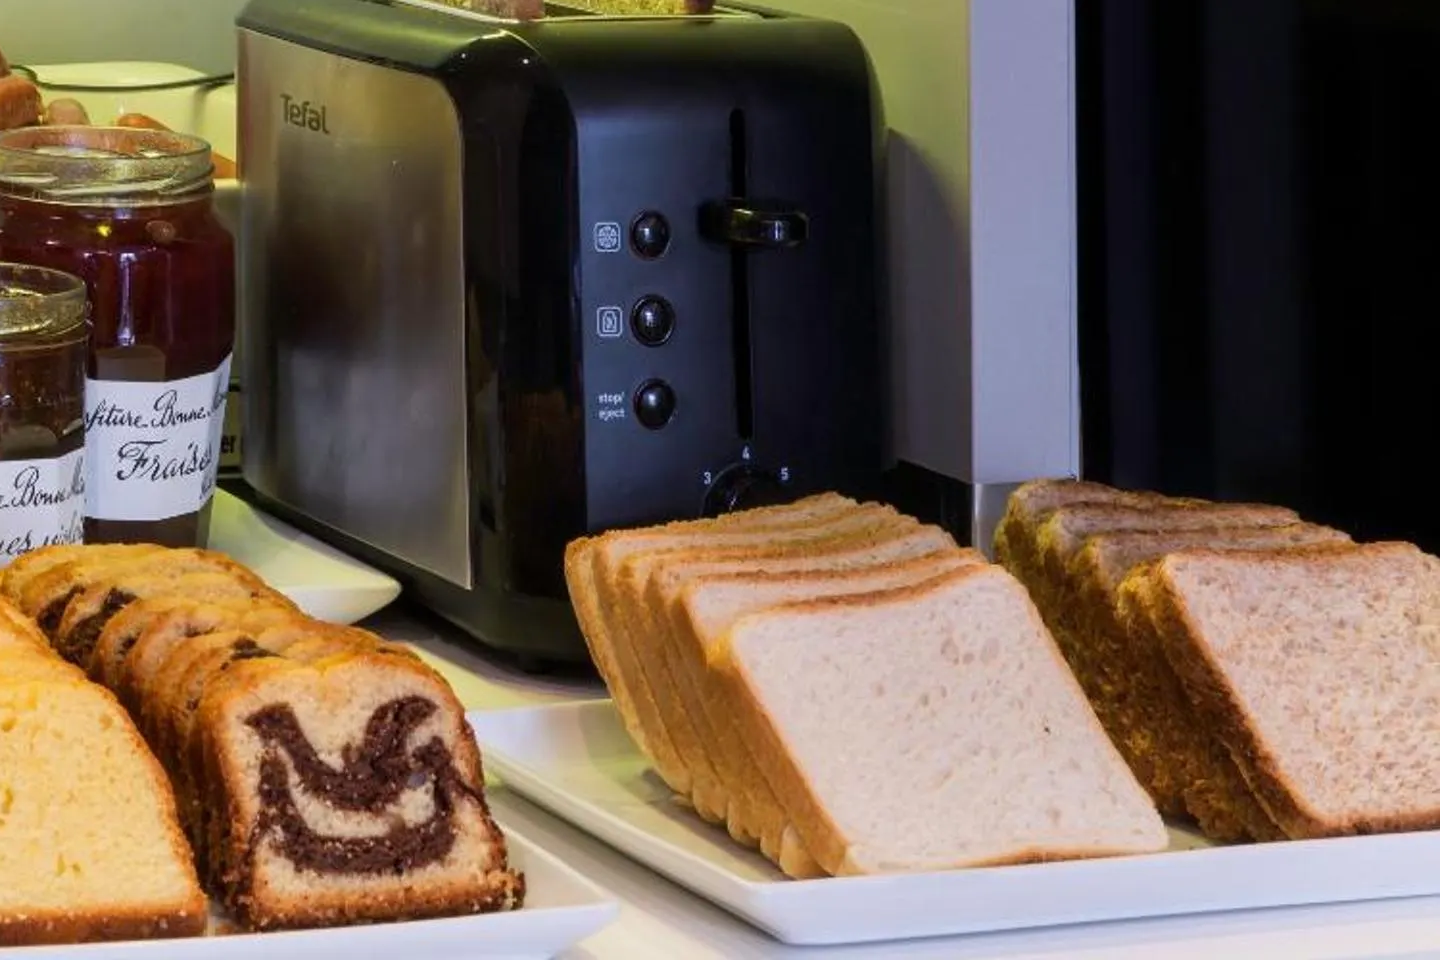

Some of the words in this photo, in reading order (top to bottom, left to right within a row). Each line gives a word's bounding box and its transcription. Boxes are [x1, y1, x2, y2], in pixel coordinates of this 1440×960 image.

[280, 93, 330, 135] Tefal
[151, 390, 207, 428] Bonne
[598, 406, 625, 422] eject
[742, 445, 750, 460] 4
[703, 471, 712, 485] 3
[780, 466, 789, 481] 5
